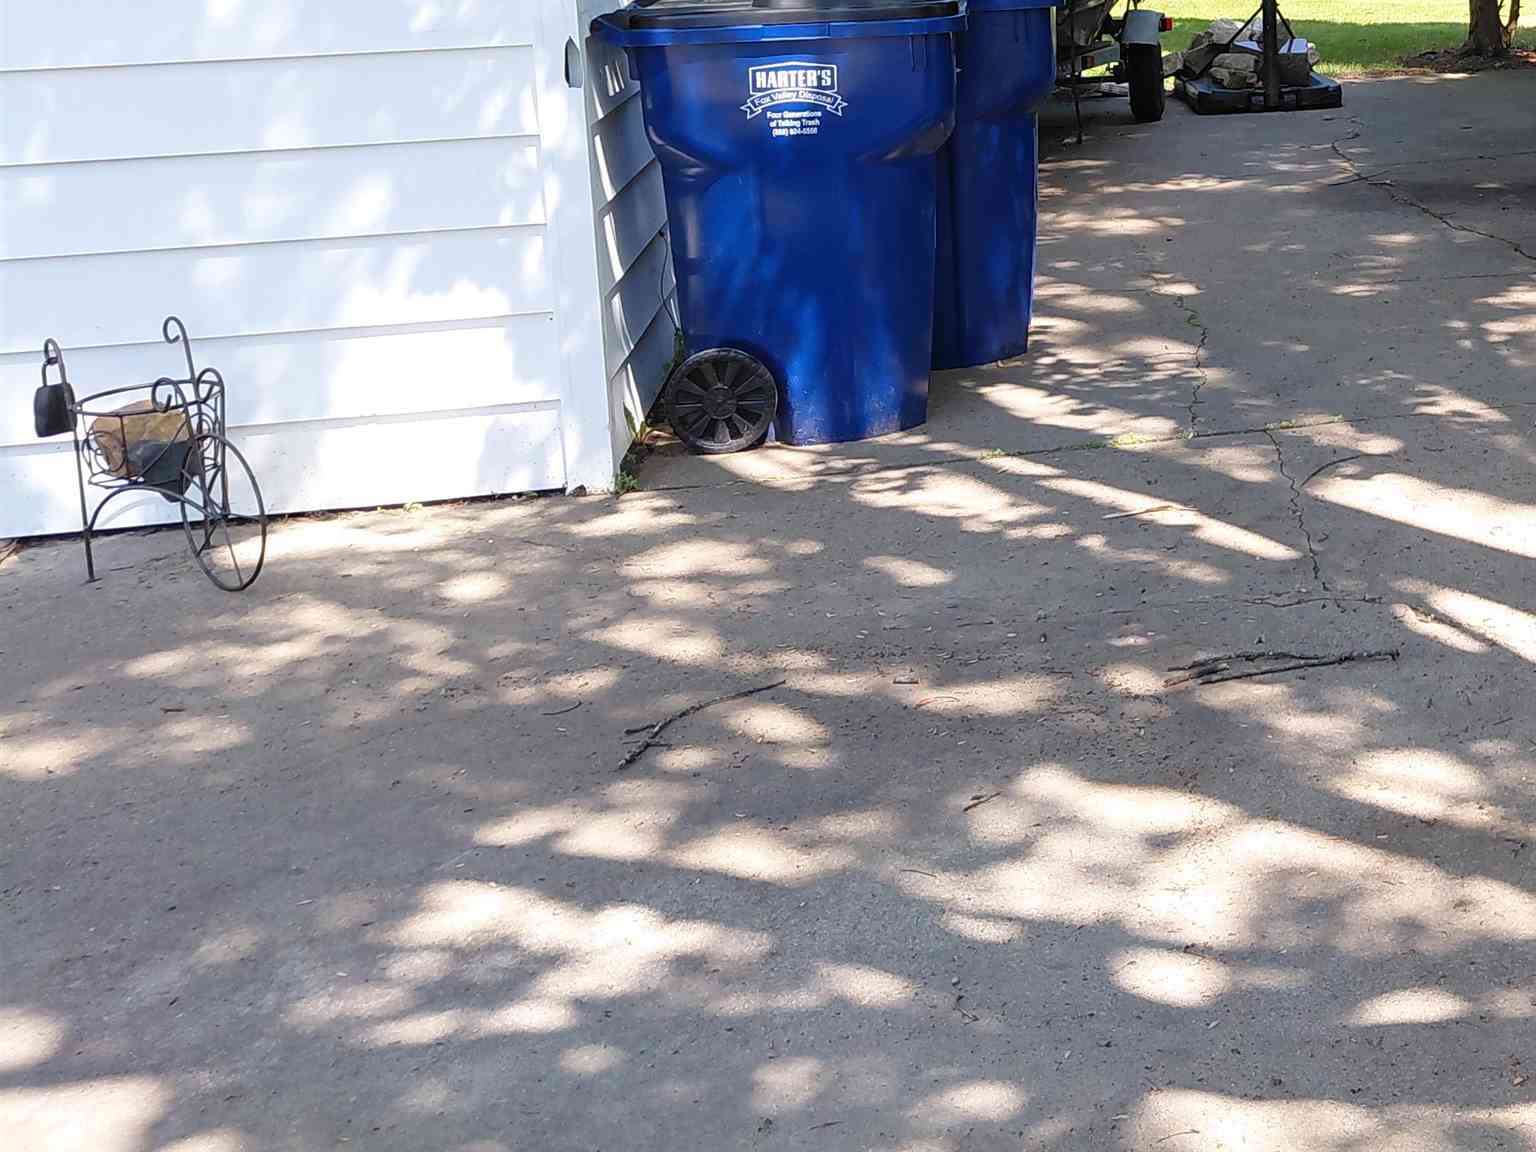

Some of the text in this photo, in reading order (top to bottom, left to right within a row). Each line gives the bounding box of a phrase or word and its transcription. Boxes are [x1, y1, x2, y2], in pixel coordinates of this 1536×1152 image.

[755, 69, 831, 88] HARTER'S
[754, 90, 834, 106] Fox Valley Disposal
